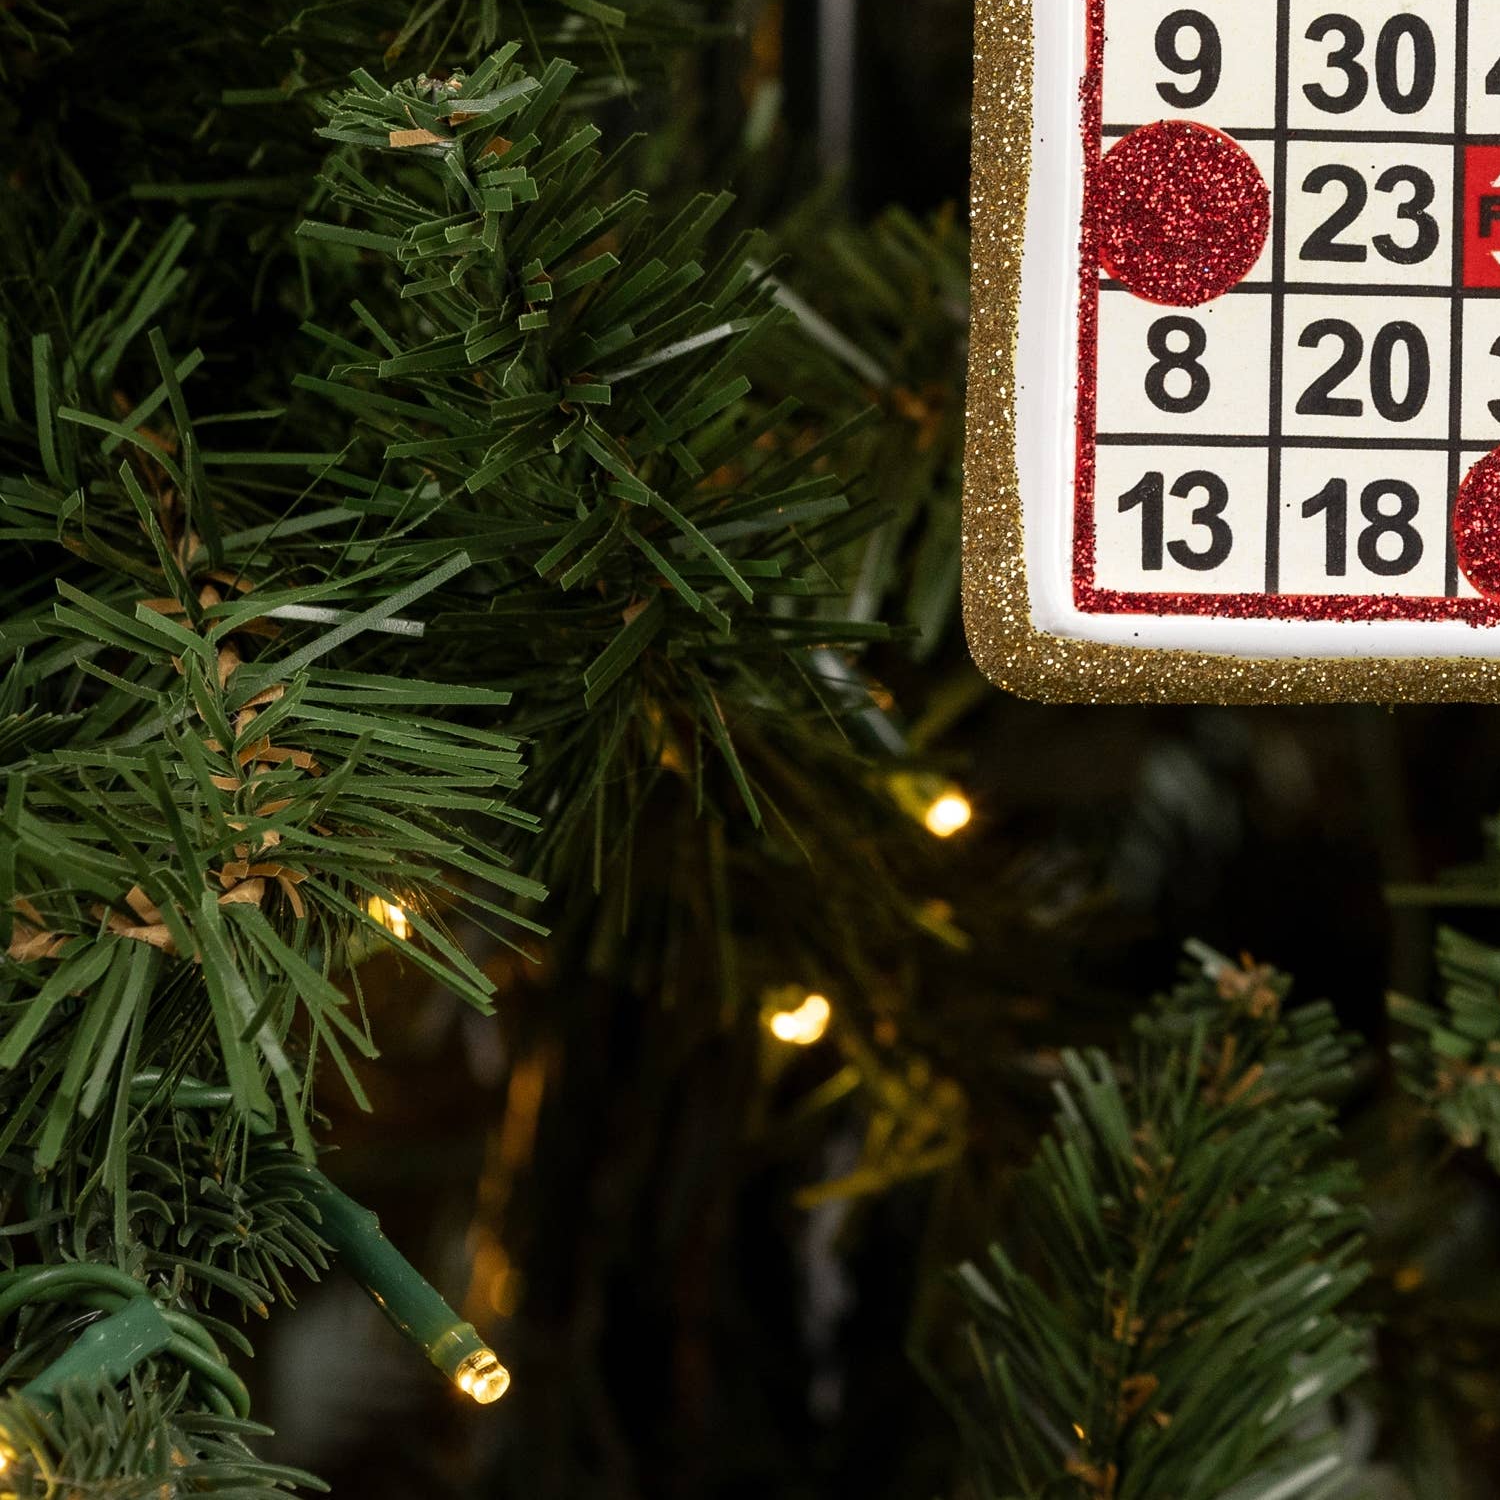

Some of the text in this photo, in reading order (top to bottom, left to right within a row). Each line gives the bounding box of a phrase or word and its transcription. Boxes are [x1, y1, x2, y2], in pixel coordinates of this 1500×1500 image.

[1155, 10, 1221, 108] 9
[1303, 13, 1435, 114] 30
[1300, 165, 1439, 264] 23
[1145, 316, 1210, 413] 8
[1296, 319, 1430, 422] 20
[1118, 471, 1232, 570] 13
[1302, 478, 1423, 576] 18
